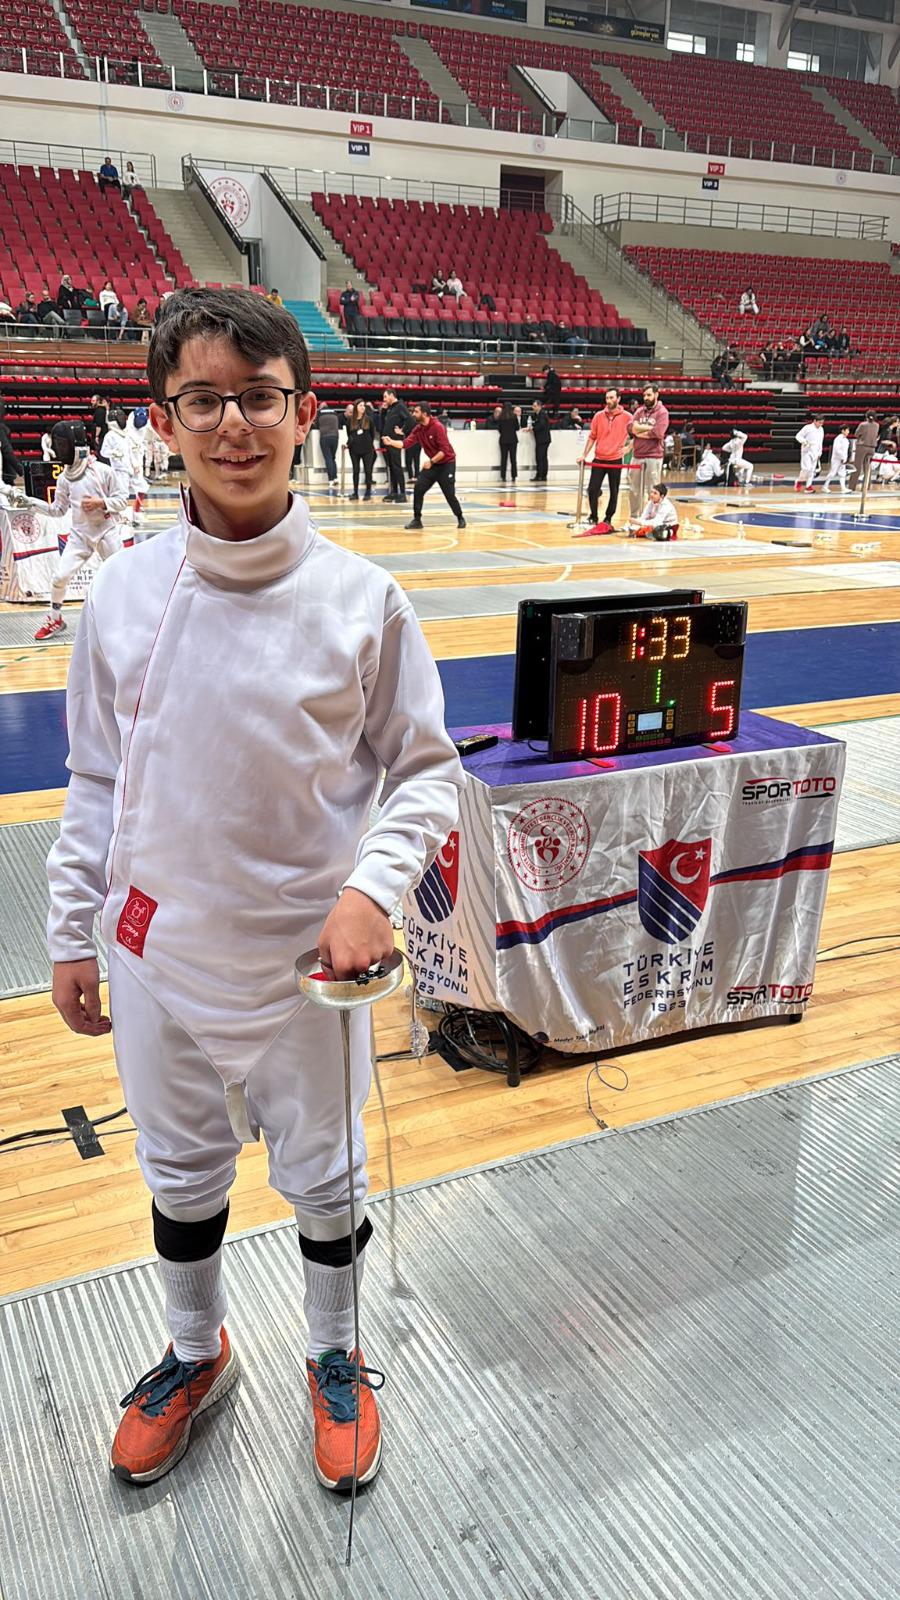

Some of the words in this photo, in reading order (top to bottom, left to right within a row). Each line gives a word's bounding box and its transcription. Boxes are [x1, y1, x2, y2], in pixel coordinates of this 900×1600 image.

[353, 123, 365, 133] VIP
[351, 144, 363, 152] VIP
[710, 164, 720, 172] VIP
[629, 616, 692, 661] 1:33
[580, 692, 622, 752] 10
[709, 679, 736, 737] 5
[408, 939, 468, 981] SKRİM
[623, 941, 714, 977] TÜRKİYE
[409, 962, 468, 994] RASYONU
[416, 979, 435, 995] 23
